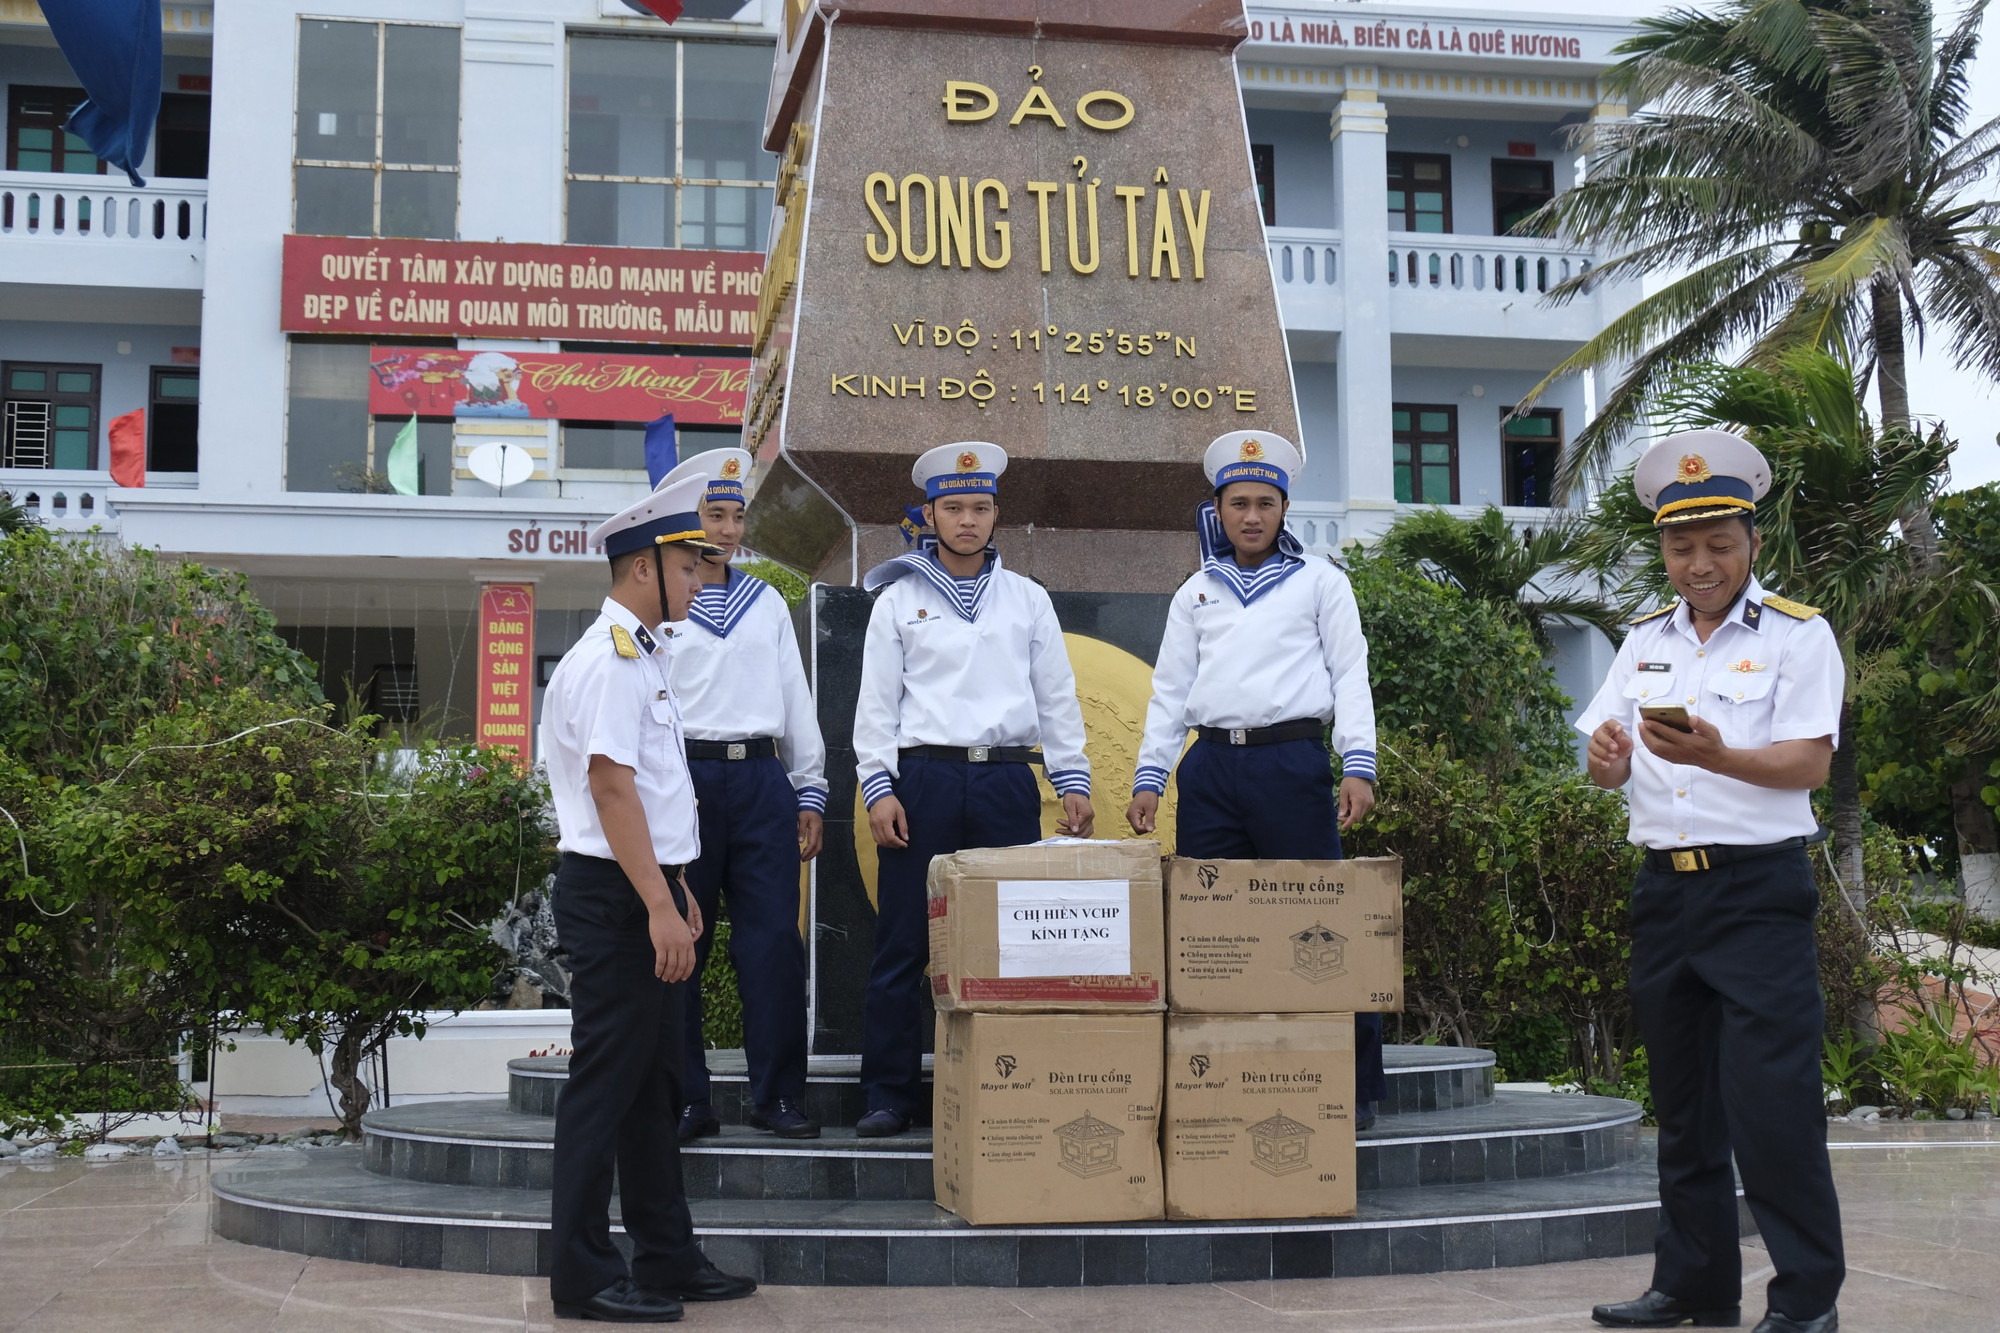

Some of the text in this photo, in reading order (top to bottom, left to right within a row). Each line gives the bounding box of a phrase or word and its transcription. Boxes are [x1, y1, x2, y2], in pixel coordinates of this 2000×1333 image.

[1270, 16, 1295, 43] LÀ
[1301, 19, 1348, 48] NHÀ,
[1354, 19, 1400, 48] BIỂN
[1406, 22, 1432, 50] CẢ
[1438, 26, 1462, 51] LÀ
[1468, 29, 1505, 54] QUÊ
[1511, 34, 1580, 58] HƯƠNG
[942, 65, 1135, 130] ĐẢO
[864, 172, 1011, 269] SONG
[1027, 155, 1101, 274] TỬ
[1115, 166, 1211, 279] TÂY
[322, 247, 391, 281] QUYẾT
[400, 253, 447, 284] TÂM
[454, 255, 496, 286] XÂY
[503, 260, 563, 291] DỰNG
[570, 257, 613, 290] ĐẢO
[620, 267, 684, 296] MẠNH
[691, 261, 716, 294] VỀ
[303, 294, 348, 324] ĐẸP
[355, 288, 382, 321] VỀ
[389, 290, 449, 323] CẢNH
[459, 300, 518, 327] QUAN
[527, 298, 568, 328] MÔI
[577, 300, 668, 334] TRƯỜNG,
[675, 300, 723, 333] MẪU
[892, 318, 926, 346] VĨ
[933, 318, 980, 355] ĐỘ
[519, 362, 608, 392] Chúc
[831, 373, 925, 398] KINH
[938, 369, 996, 407] ĐỘ
[508, 520, 587, 554] SỞ CHỈ
[489, 618, 524, 634] ĐẢNG
[489, 640, 524, 657] CỘNG
[493, 659, 519, 675] SẢN
[492, 680, 519, 697] VIỆT
[490, 703, 519, 716] NAM
[483, 723, 525, 737] QUANG
[1249, 876, 1345, 895] Đèn trụ cổng
[1180, 893, 1233, 903] Mayor Wolf
[1014, 910, 1039, 923] CHỊ
[1082, 908, 1120, 919] VCHP
[1031, 926, 1067, 940] KÍNH
[1370, 993, 1393, 1002] 250
[1049, 1068, 1132, 1085] Đèn trụ cổng
[1242, 1068, 1322, 1085] Đèn trụ cổng
[981, 1083, 1008, 1091] Mayor
[1175, 1082, 1201, 1091] Mayor
[1128, 1176, 1146, 1184] 400
[1318, 1173, 1336, 1182] 400
